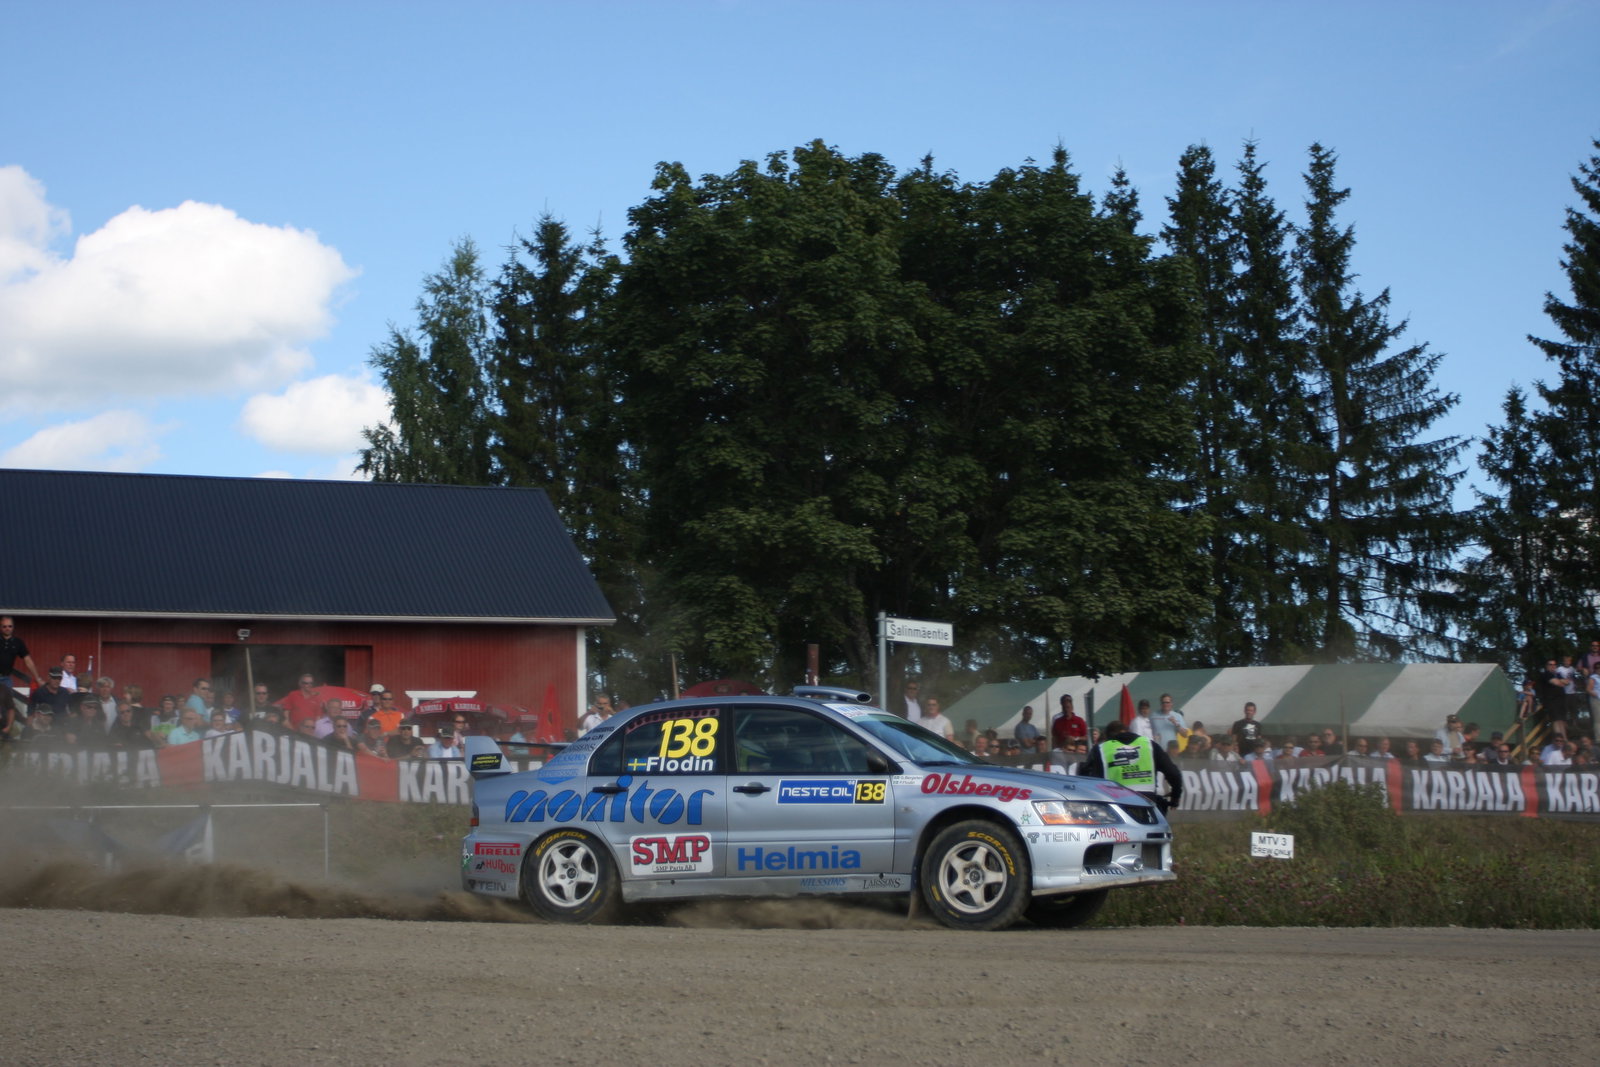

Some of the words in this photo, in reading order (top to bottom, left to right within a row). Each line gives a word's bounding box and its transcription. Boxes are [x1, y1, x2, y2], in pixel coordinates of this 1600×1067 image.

[890, 624, 949, 641] Salinmäentie
[659, 717, 719, 758] 138
[203, 730, 360, 796] KARJALA
[646, 756, 714, 772] Flodin
[399, 760, 474, 805] KAR
[781, 787, 829, 797] NESTE
[831, 787, 852, 797] OIL
[856, 783, 886, 801] 138
[920, 773, 1033, 802] Olsbergs
[1157, 767, 1259, 811] RJALA
[1411, 768, 1526, 812] KARJALA
[1545, 772, 1600, 814] KAR
[505, 775, 715, 825] monitor
[474, 843, 521, 856] PIRELLI
[535, 831, 588, 857] SCORPION
[632, 835, 711, 865] SMP
[1042, 832, 1080, 842] TEIN
[1258, 836, 1278, 845] MTV
[1281, 837, 1287, 847] 3
[738, 845, 861, 871] Helmia
[966, 831, 1016, 876] SCORPION
[479, 881, 507, 891] TEIN
